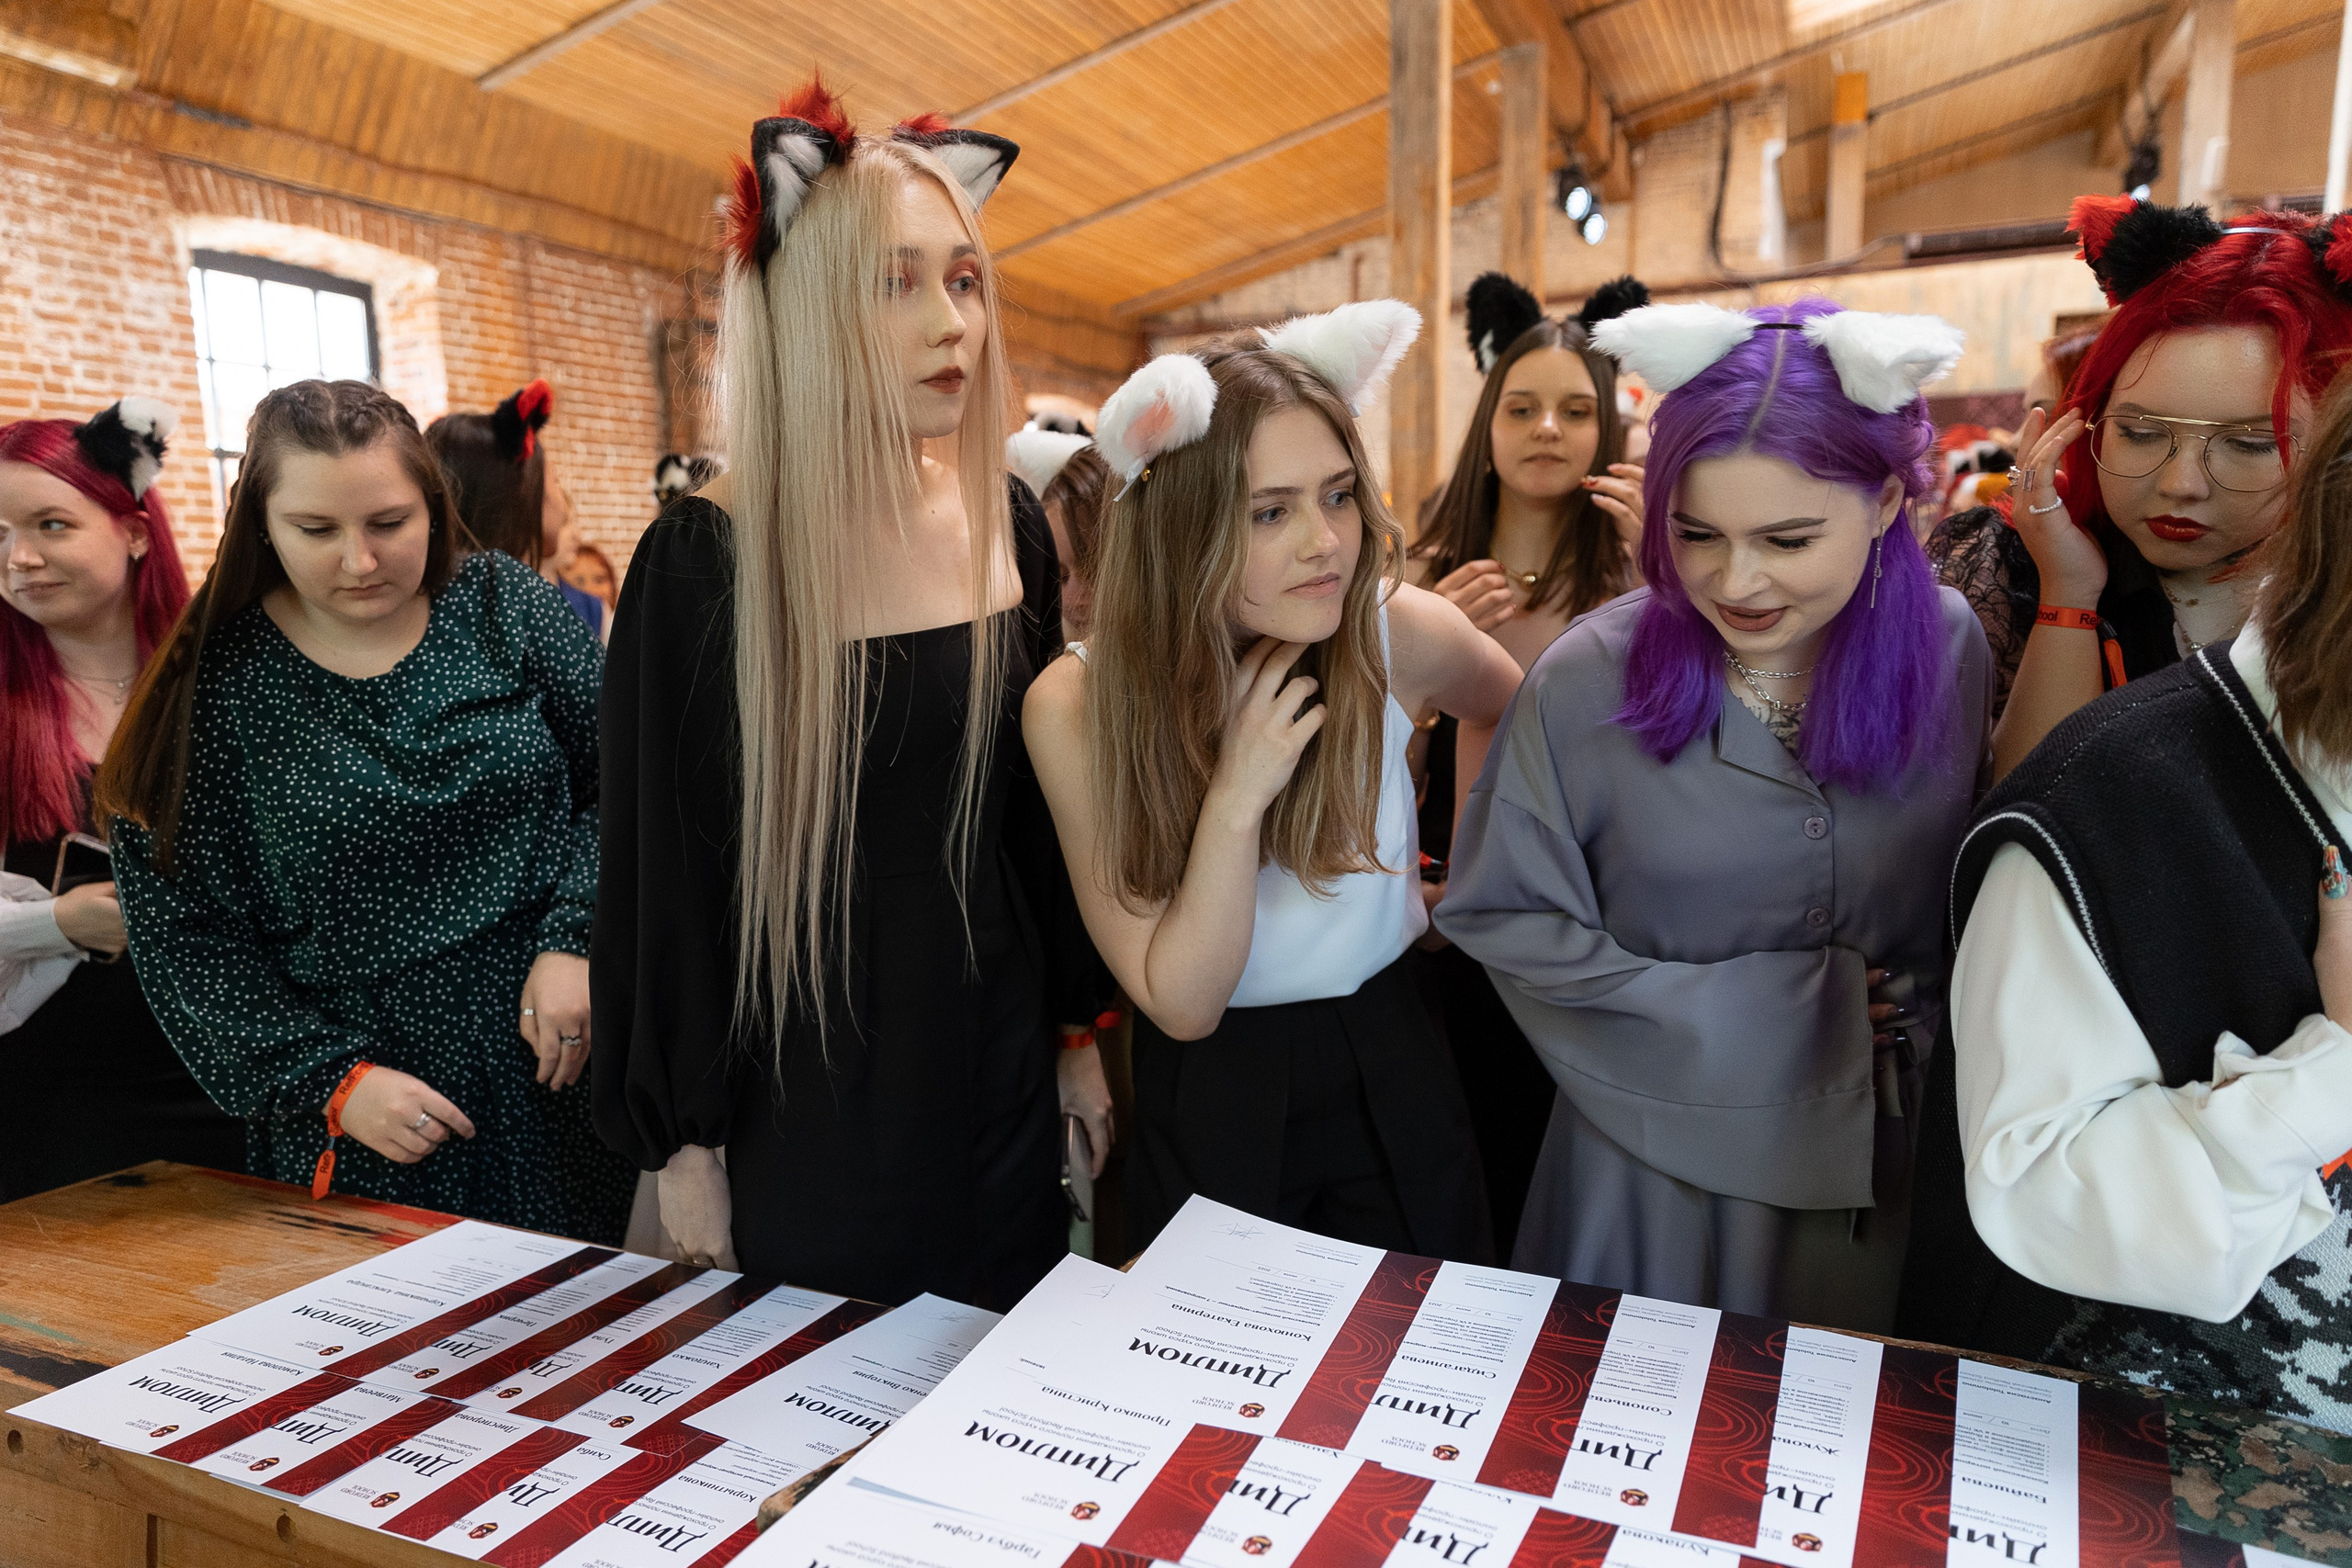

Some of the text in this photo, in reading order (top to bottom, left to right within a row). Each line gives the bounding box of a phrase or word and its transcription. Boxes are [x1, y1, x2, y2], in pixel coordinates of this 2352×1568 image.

[292, 1305, 398, 1337] Диплом
[1171, 1303, 1311, 1341] Конюхова Екатерина
[1140, 1327, 1286, 1365] прохождении полного курса школы
[1155, 1325, 1298, 1365] онлайн-профессий Redford School
[672, 1353, 720, 1369] Хандожко
[1129, 1337, 1291, 1387] Диплом
[1401, 1355, 1497, 1379] Сидагалиева
[852, 1371, 901, 1390] Виктория
[129, 1376, 245, 1413] Диплом
[354, 1386, 404, 1403] Матвеева
[805, 1385, 870, 1409] полного курса школы
[818, 1384, 865, 1402] Redford School
[1397, 1380, 1487, 1400] онлайн-профессий
[1411, 1388, 1474, 1404] прохождении
[1041, 1386, 1170, 1427] Прошко Кристина
[1192, 1399, 1232, 1410] REDFORD
[1202, 1396, 1235, 1406] SCHOOL
[136, 1418, 160, 1427] SCHOOL
[577, 1411, 608, 1421] REDFORD
[587, 1409, 614, 1418] SCHOOL
[125, 1421, 152, 1431] REDFORD
[981, 1408, 1136, 1454] прохождении полного курса школы
[998, 1406, 1150, 1450] онлайн-профессий Redford School
[1586, 1427, 1653, 1443] прохождении
[424, 1440, 467, 1455] прохождении
[805, 1442, 836, 1456] REDFORD
[815, 1441, 842, 1452] SCHOOL
[1381, 1438, 1425, 1452] REDFORD
[1391, 1436, 1427, 1448] SCHOOL
[1770, 1434, 1838, 1455] Жукова
[219, 1453, 251, 1464] REDFORD
[231, 1450, 258, 1461] SCHOOL
[576, 1447, 611, 1461] Скиба
[965, 1422, 1138, 1482] Диплом
[340, 1487, 371, 1499] REDFORD
[351, 1484, 379, 1495] SCHOOL
[678, 1475, 757, 1503] Корытникова
[1962, 1476, 2046, 1504] Байшева
[654, 1500, 725, 1524] онлайн-профессий
[661, 1509, 709, 1527] прохождении
[933, 1522, 1040, 1559] Гарбуз Софья
